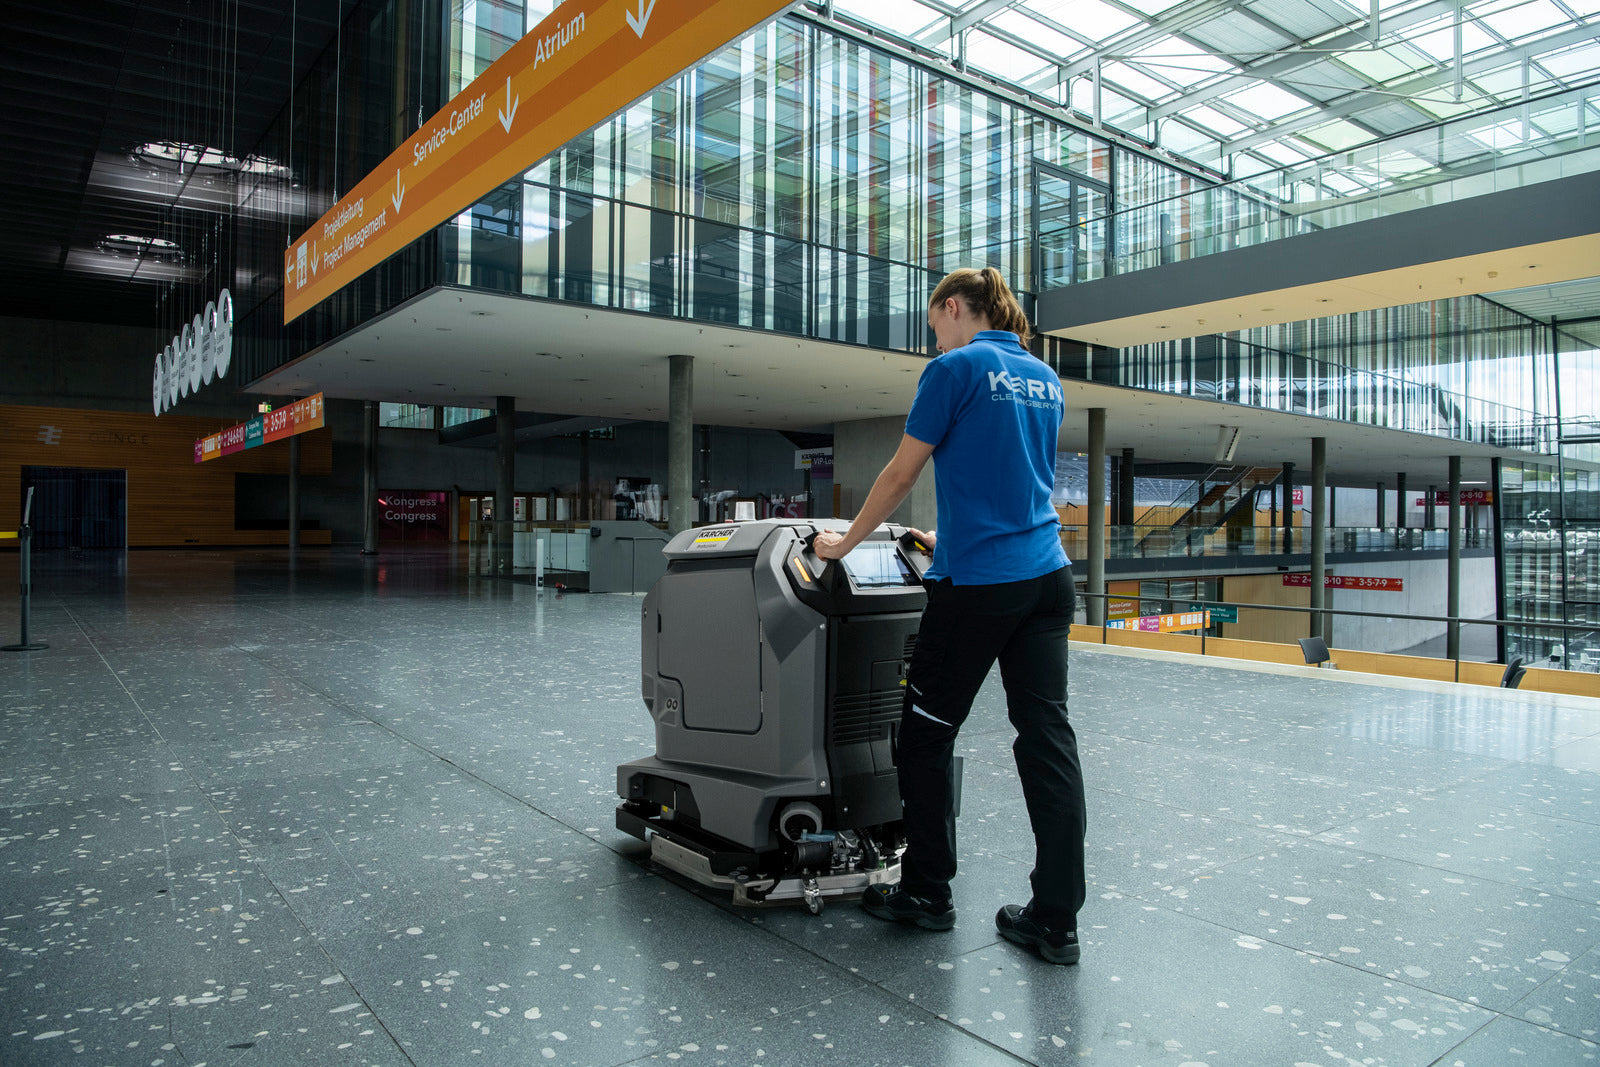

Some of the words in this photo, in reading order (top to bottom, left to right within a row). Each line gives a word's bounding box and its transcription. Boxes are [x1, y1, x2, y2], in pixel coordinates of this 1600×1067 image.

[534, 11, 585, 70] Atrium
[413, 92, 486, 167] Service-Center
[323, 242, 343, 270] Project
[344, 208, 386, 255] Management
[324, 197, 364, 241] Projektleitung
[385, 496, 437, 509] Kongress
[385, 510, 437, 523] Congress
